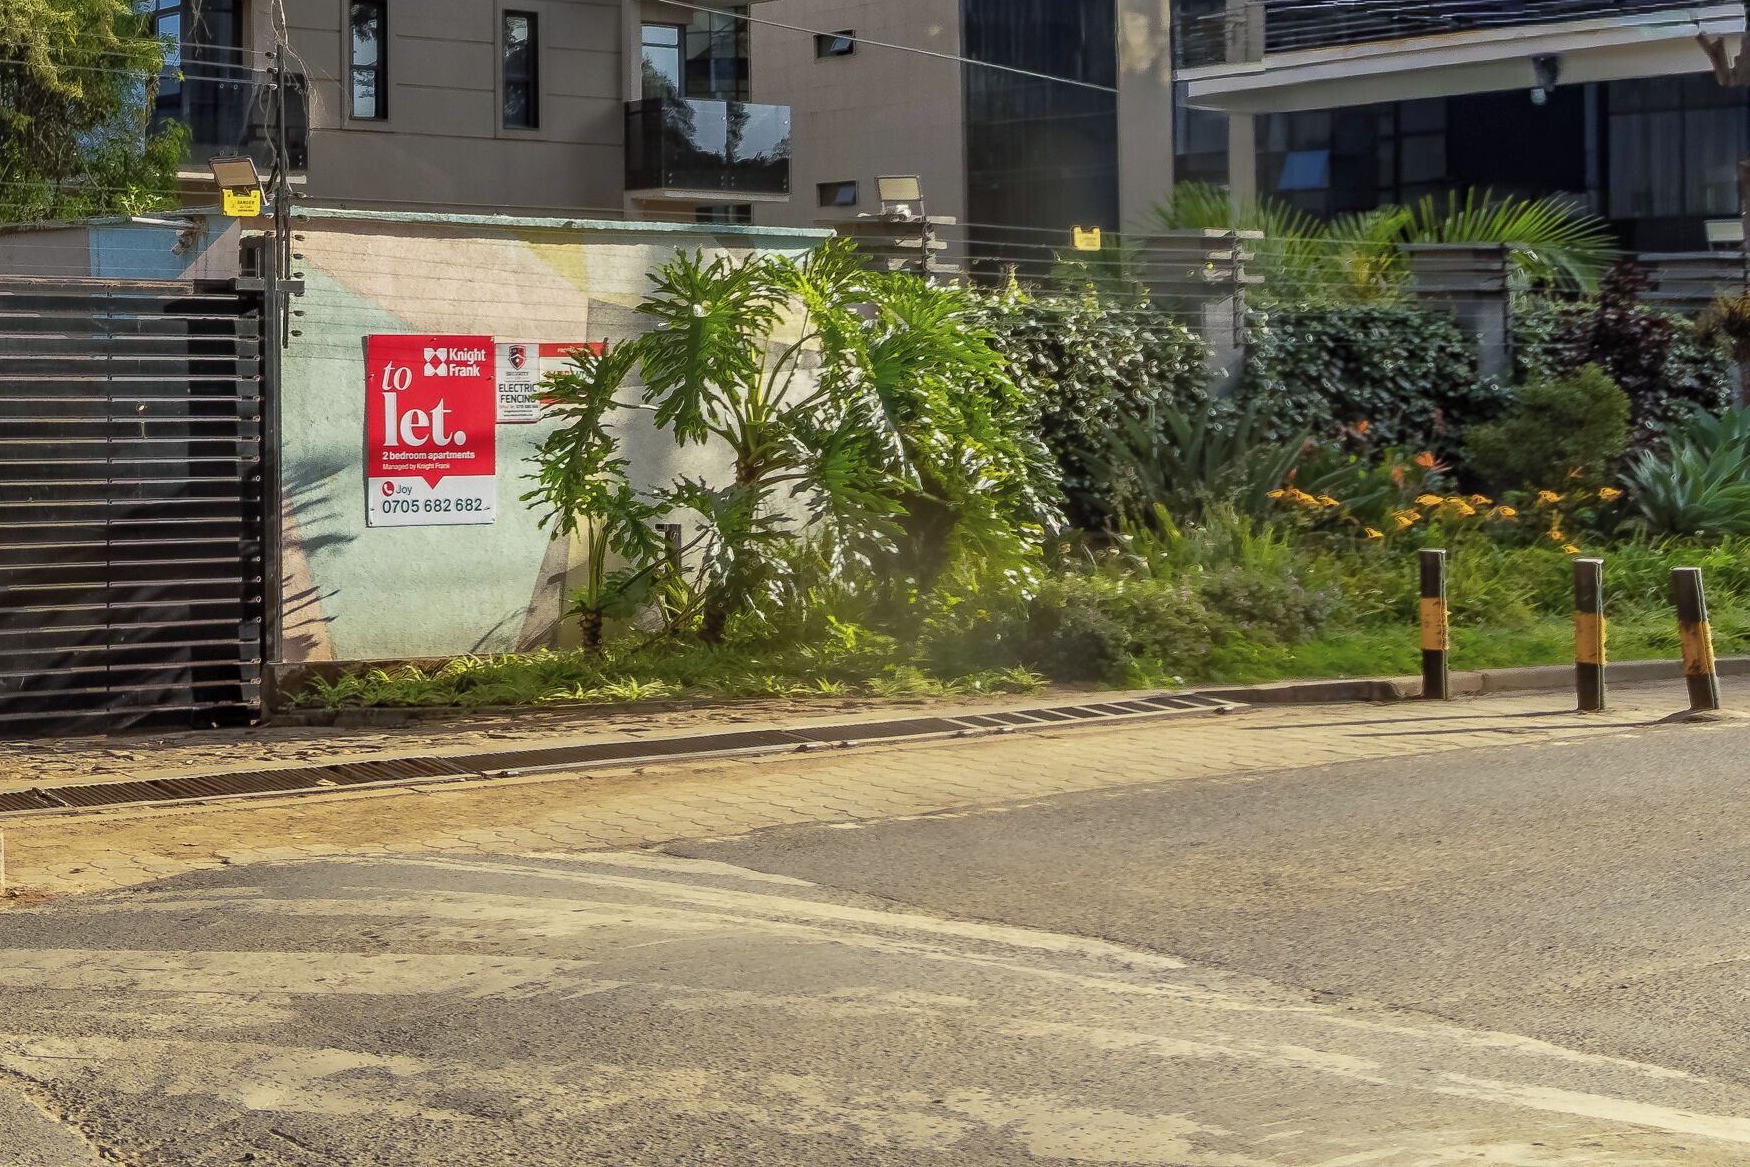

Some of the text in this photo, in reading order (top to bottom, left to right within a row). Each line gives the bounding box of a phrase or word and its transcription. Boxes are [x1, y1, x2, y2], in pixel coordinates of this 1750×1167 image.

[449, 348, 486, 365] Knight
[381, 360, 413, 391] to
[449, 364, 481, 377] Frank
[498, 383, 538, 393] ELECTRIC
[382, 392, 467, 447] let.
[382, 450, 475, 461] 2 bedroom apartments
[382, 463, 409, 471] Managed
[409, 463, 417, 471] by
[416, 463, 435, 471] Knight
[395, 484, 412, 496] Joy
[382, 498, 482, 514] 0705 682 682
